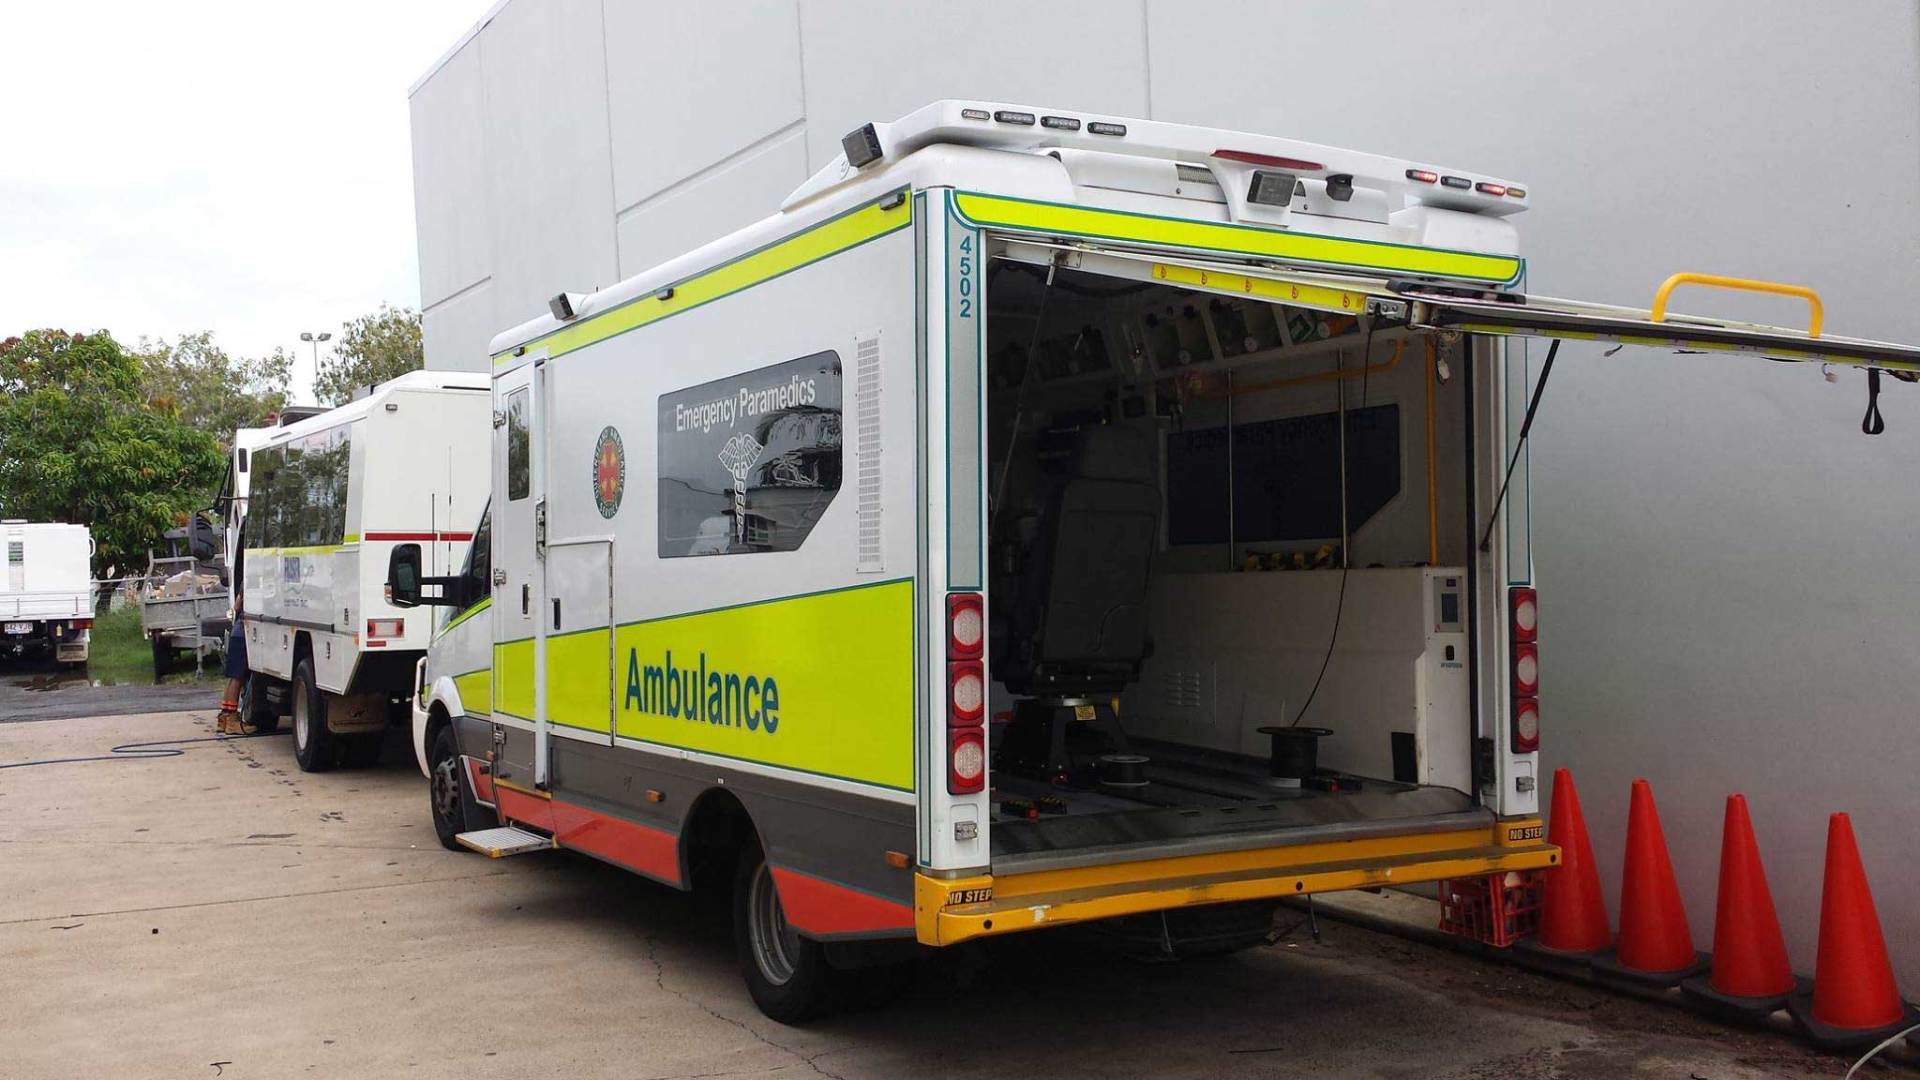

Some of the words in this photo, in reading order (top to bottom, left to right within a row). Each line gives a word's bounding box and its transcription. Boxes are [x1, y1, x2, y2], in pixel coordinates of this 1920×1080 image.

[959, 235, 972, 319] 4502
[676, 396, 737, 433] Emergency
[739, 374, 816, 418] Paramedics
[625, 648, 779, 734] Ambulance
[1510, 829, 1523, 839] NO
[944, 891, 962, 905] NO
[965, 889, 992, 903] STEP
